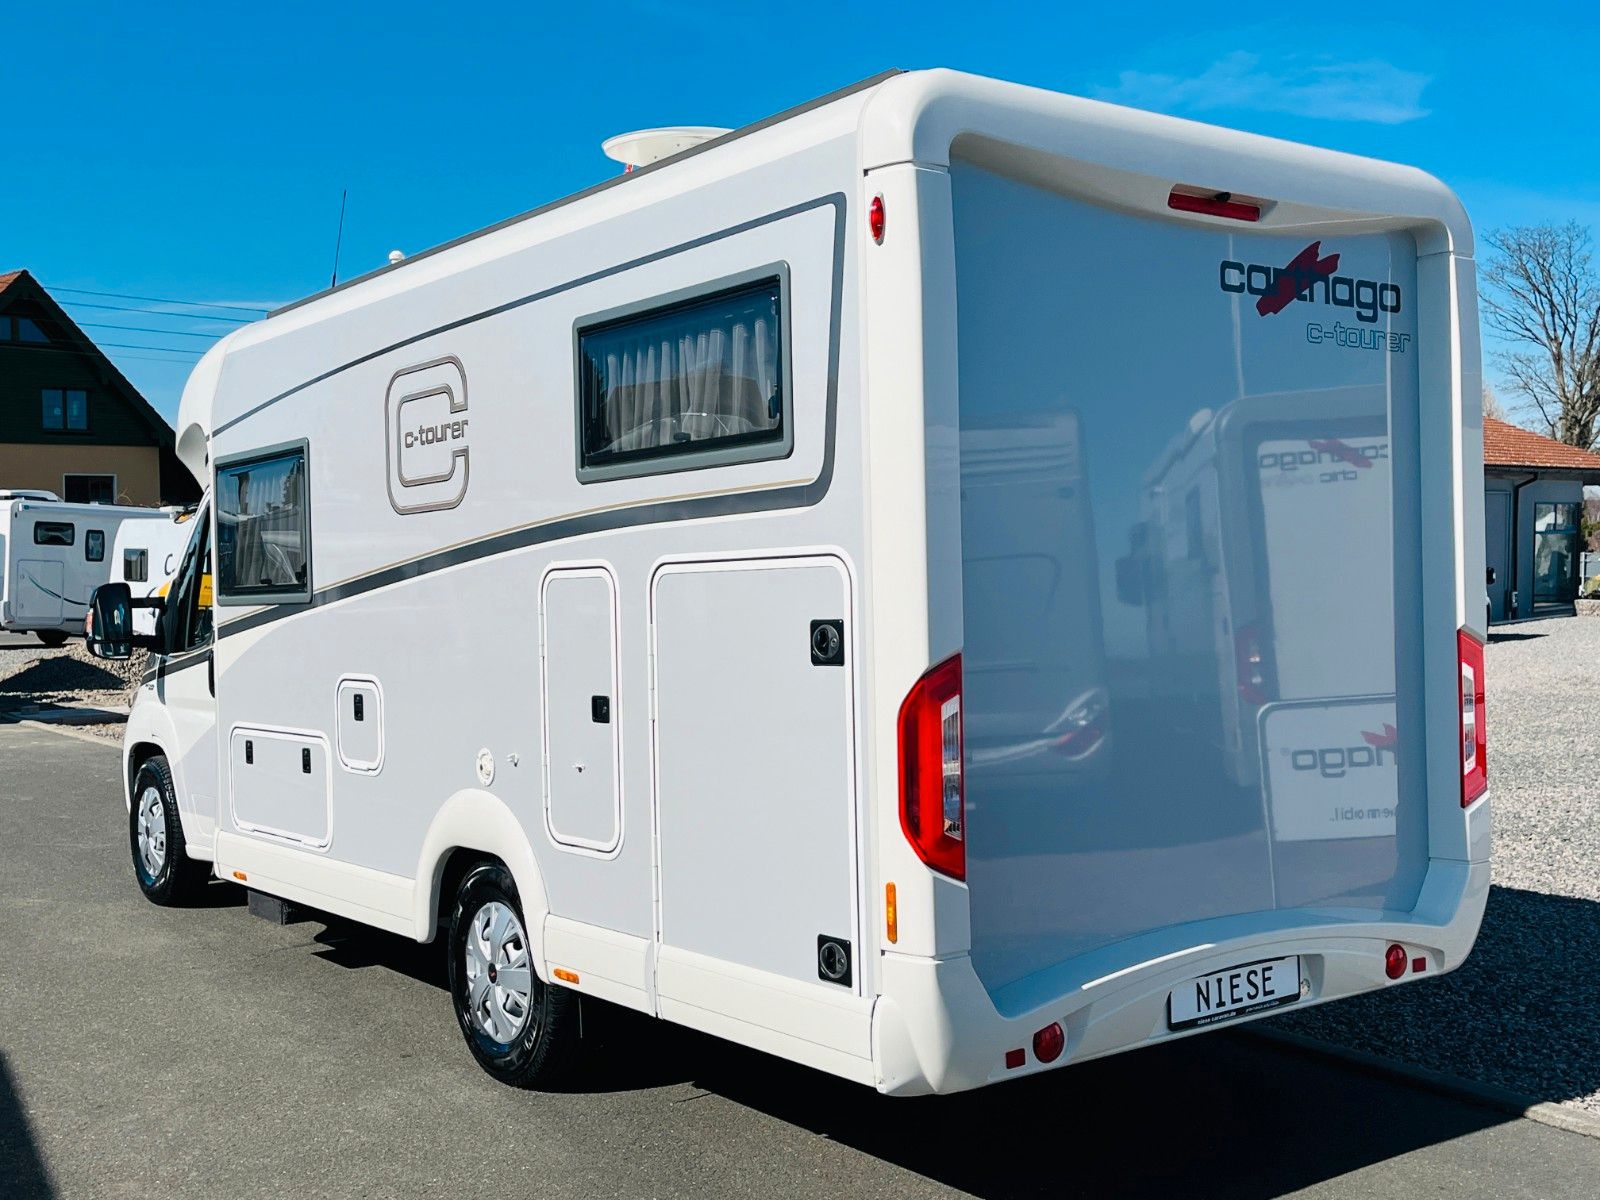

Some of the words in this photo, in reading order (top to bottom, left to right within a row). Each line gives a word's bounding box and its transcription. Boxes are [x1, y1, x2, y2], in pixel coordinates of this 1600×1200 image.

[1220, 260, 1401, 323] carthago
[1306, 321, 1411, 353] c-tourer
[404, 419, 469, 449] c-tourer
[1196, 966, 1275, 1012] NIESE
